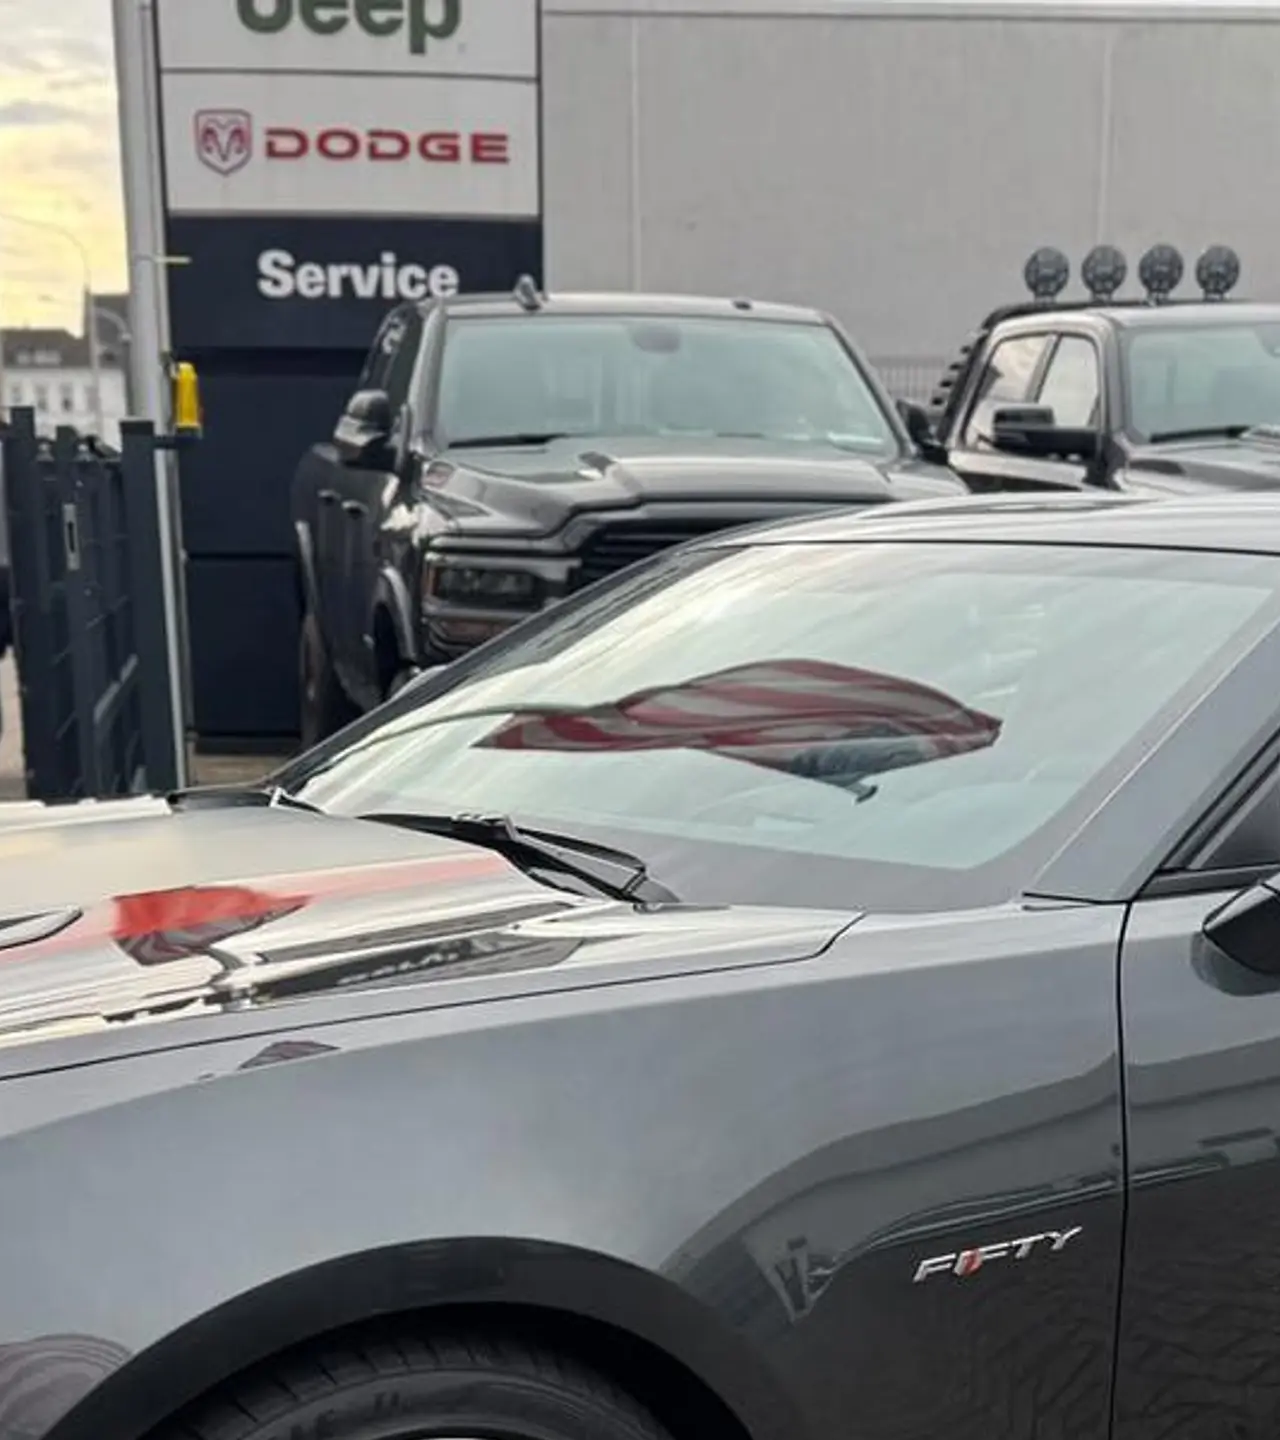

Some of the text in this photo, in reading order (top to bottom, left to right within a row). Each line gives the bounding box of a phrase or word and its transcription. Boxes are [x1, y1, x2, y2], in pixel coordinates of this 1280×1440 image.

[264, 127, 510, 164] DODGE
[256, 249, 460, 299] Service
[912, 1226, 1083, 1283] FIFTY
